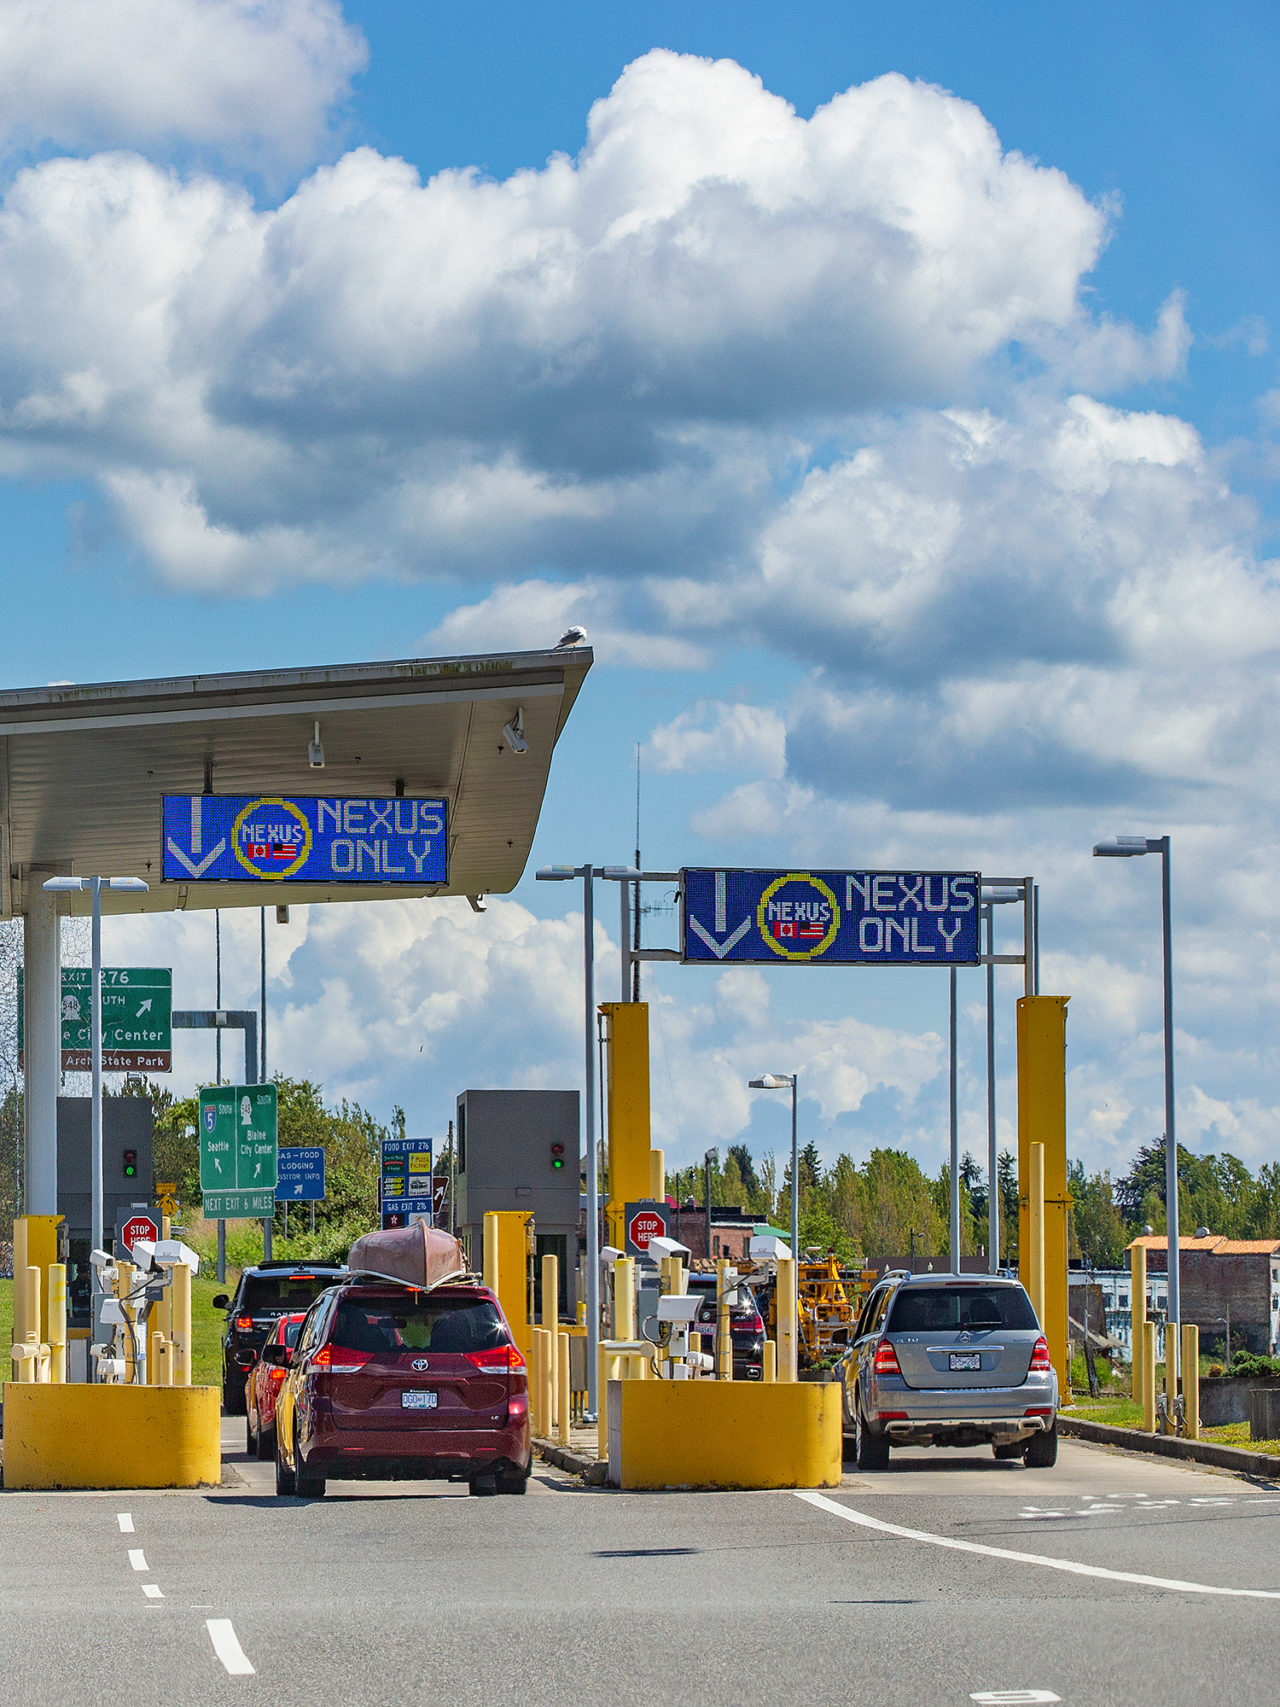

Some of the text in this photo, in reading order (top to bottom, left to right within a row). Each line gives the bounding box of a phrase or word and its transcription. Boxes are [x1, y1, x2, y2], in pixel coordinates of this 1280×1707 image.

[317, 799, 443, 835] NEXUS
[242, 824, 302, 843] NEXUS
[331, 839, 430, 873] ONLY
[846, 875, 975, 912] NEXUS
[768, 901, 830, 921] NEXUS
[859, 917, 962, 953] ONLY
[62, 1001, 79, 1011] 548
[87, 996, 126, 1005] SUTH
[77, 1028, 107, 1043] Ciy
[114, 1028, 164, 1041] Center
[65, 1055, 164, 1067] Arch State Park
[207, 1113, 213, 1129] 5
[247, 1130, 266, 1141] Blaine
[207, 1141, 230, 1152] Seattle
[240, 1143, 273, 1158] City Center
[384, 1142, 429, 1152] FOOD EXIT 276
[300, 1151, 320, 1159] FOOD
[281, 1162, 314, 1170] LODGING
[305, 1172, 320, 1180] INFO
[205, 1198, 221, 1211] NEXT
[225, 1197, 240, 1210] EXIT
[252, 1196, 273, 1210] MILES
[387, 1202, 427, 1211] GAS EXIT 276
[130, 1226, 150, 1235] STOP
[637, 1221, 658, 1230] STOP
